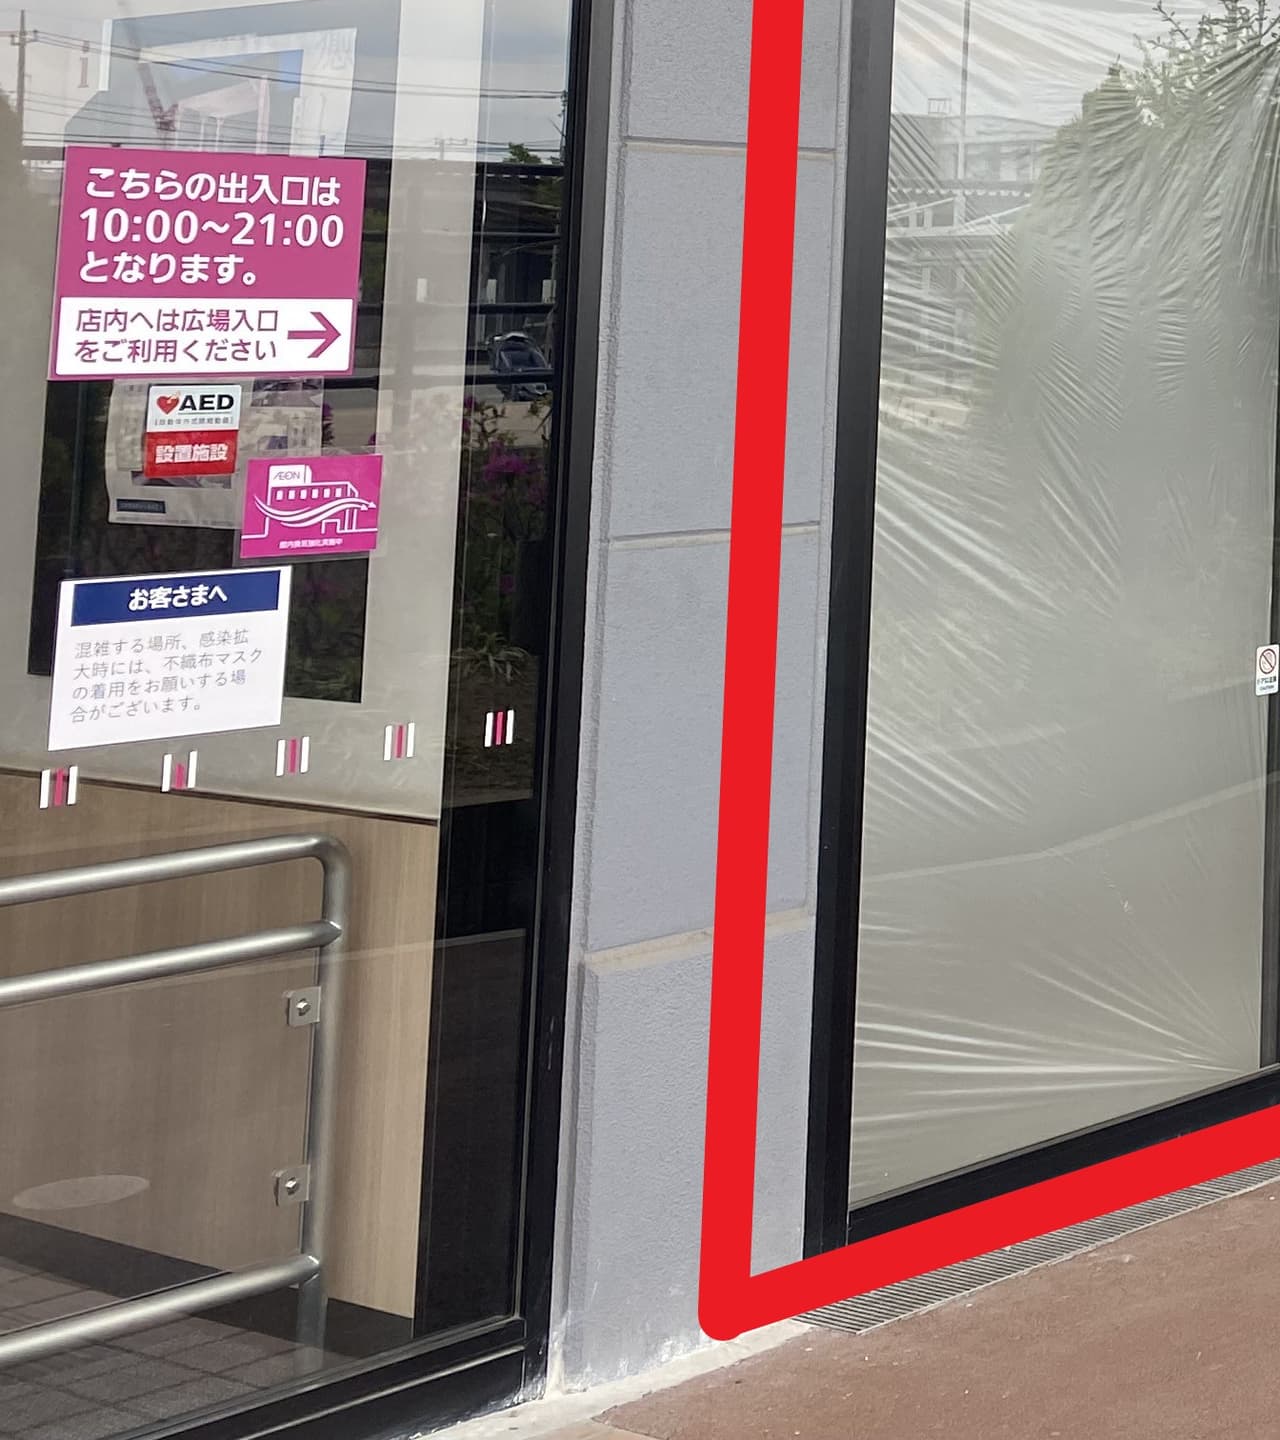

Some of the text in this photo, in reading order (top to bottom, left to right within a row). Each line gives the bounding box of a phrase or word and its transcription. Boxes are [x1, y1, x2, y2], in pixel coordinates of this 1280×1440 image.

[85, 167, 342, 206] こちらの出入口は
[79, 252, 257, 286] となります。
[75, 308, 279, 333] 店内へは広場入口
[74, 338, 277, 363] をご利用ください
[179, 394, 234, 411] AED
[155, 443, 228, 464] 設置施設
[128, 584, 228, 611] お客さまへ
[72, 669, 246, 700] の着用をお願いする場
[70, 696, 201, 723] 合がございます。
